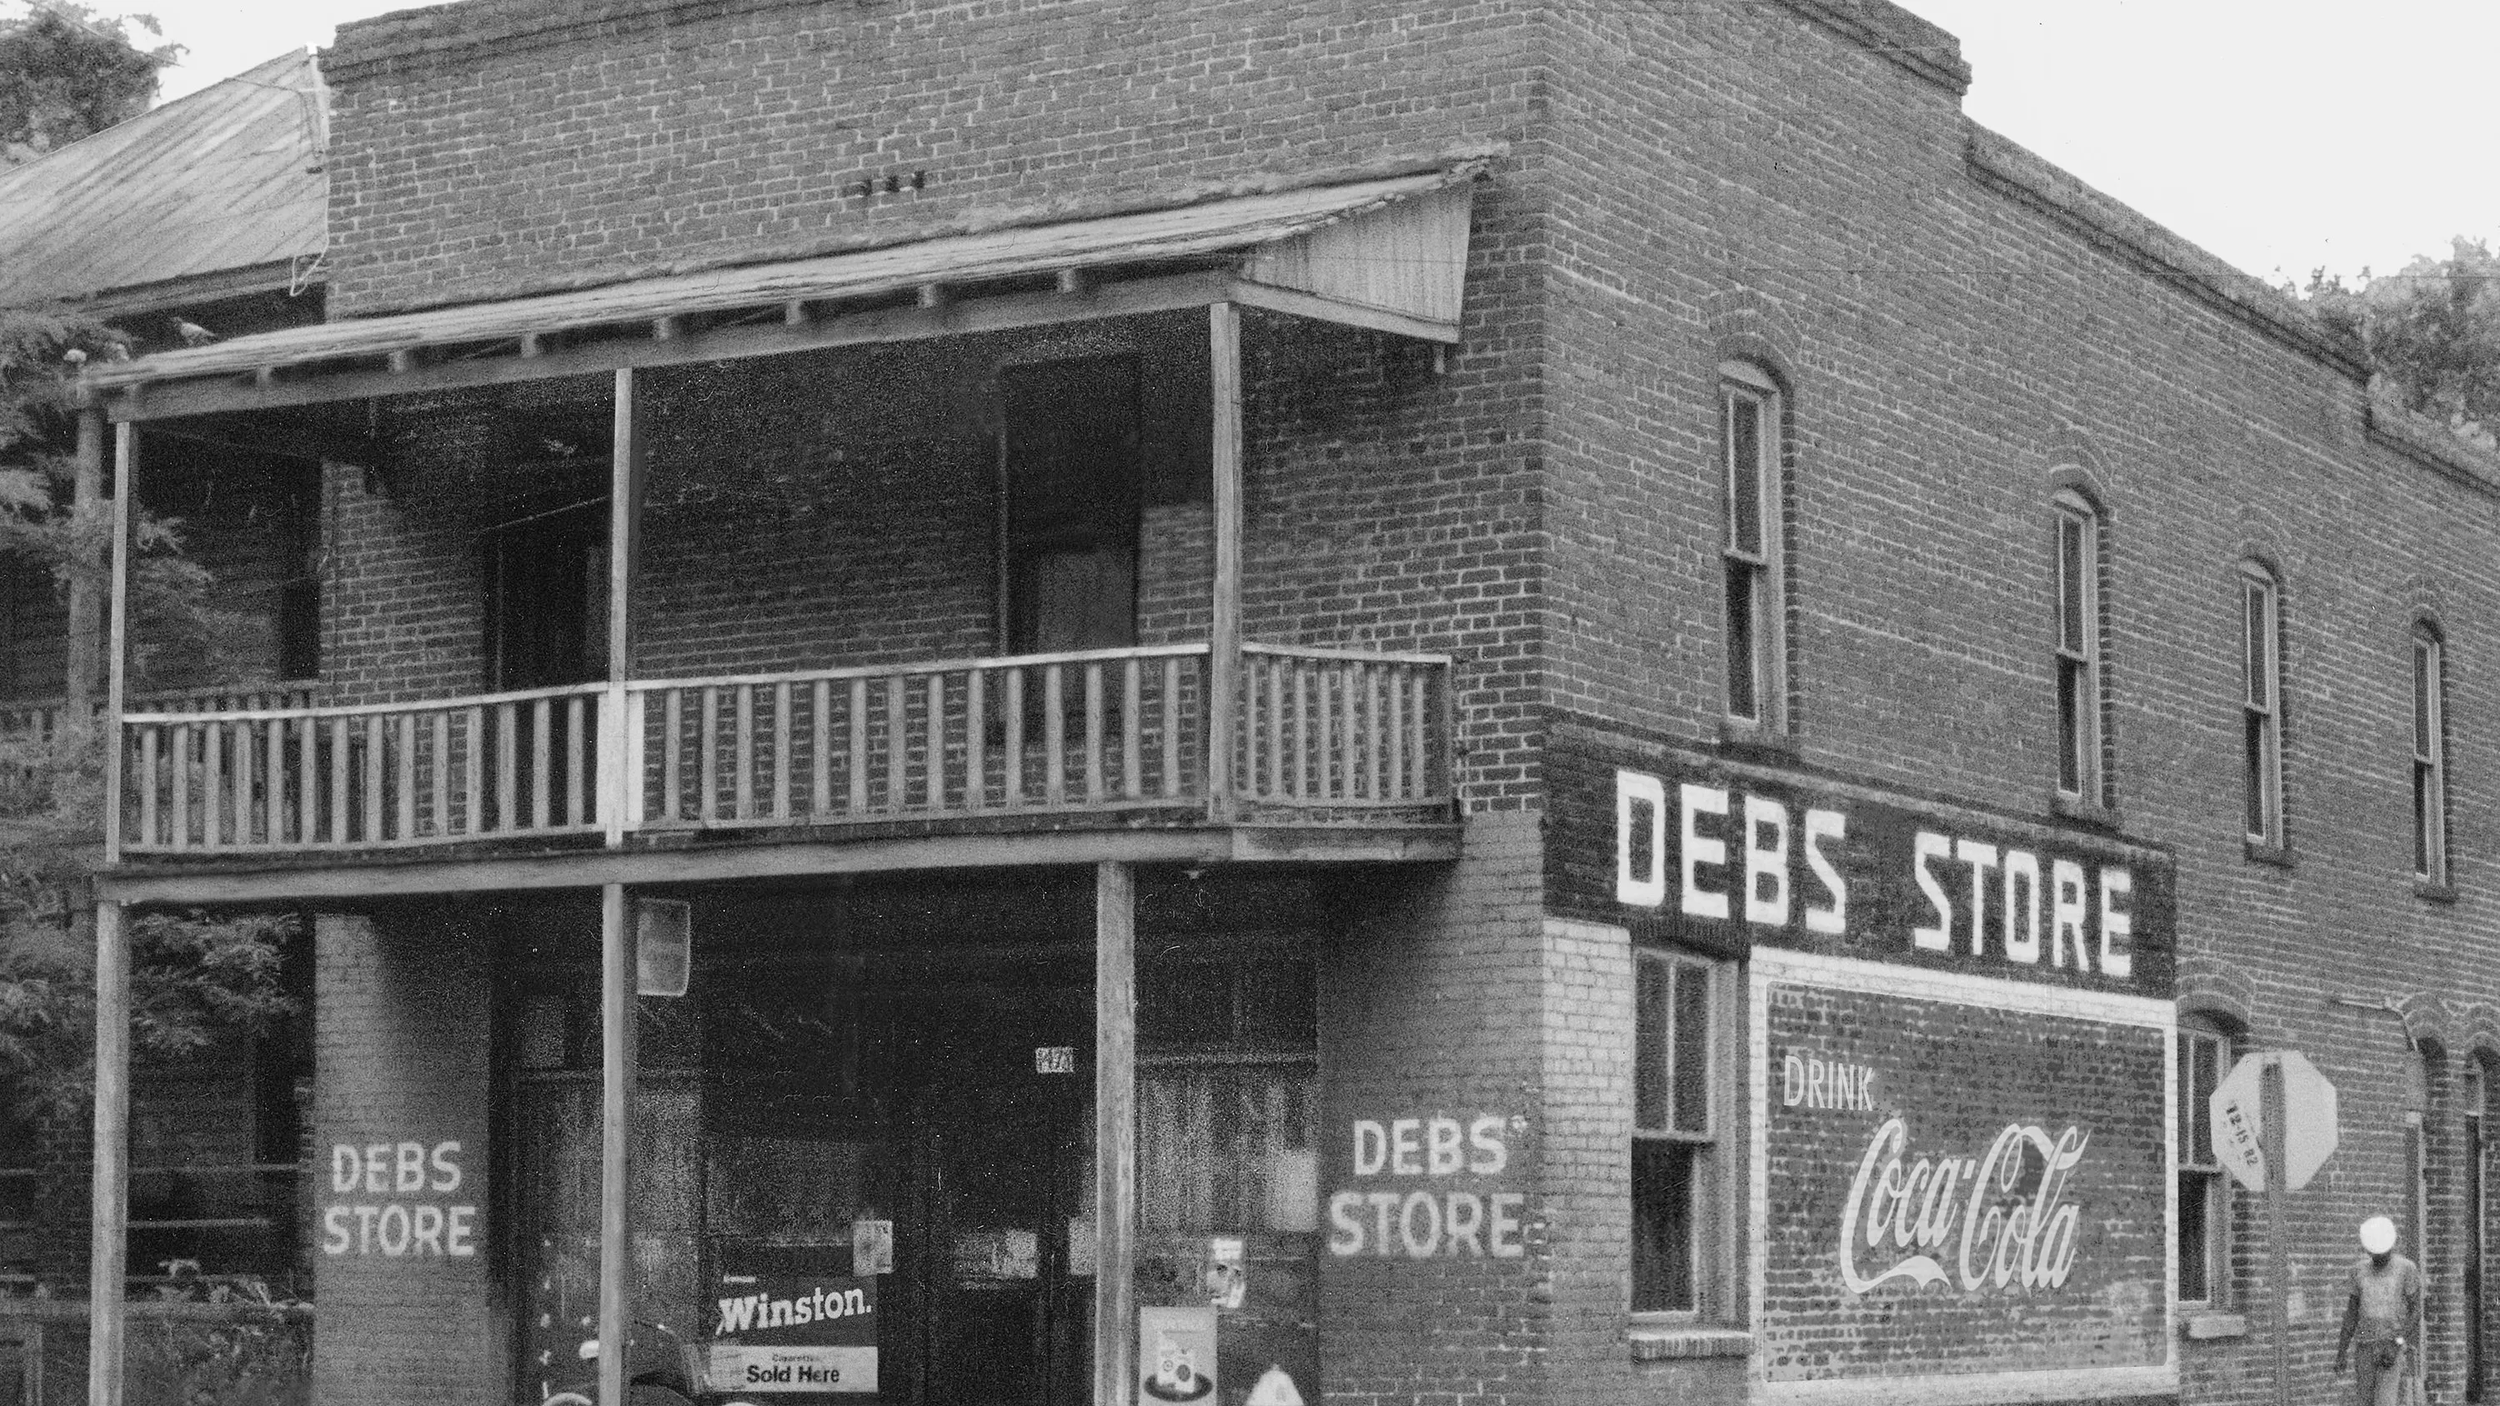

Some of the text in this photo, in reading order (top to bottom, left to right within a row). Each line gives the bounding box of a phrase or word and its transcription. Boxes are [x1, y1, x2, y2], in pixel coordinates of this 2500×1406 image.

[1616, 769, 2132, 978] DEBS STORE
[1782, 1053, 1875, 1112] DRINK
[331, 1140, 462, 1193] DEBS
[1354, 1115, 1507, 1175] DEBS
[323, 1205, 476, 1257] STORE
[1330, 1191, 1524, 1257] STORE
[1840, 1119, 2090, 1293] Coca-Cola
[746, 1364, 840, 1383] Sold Here
